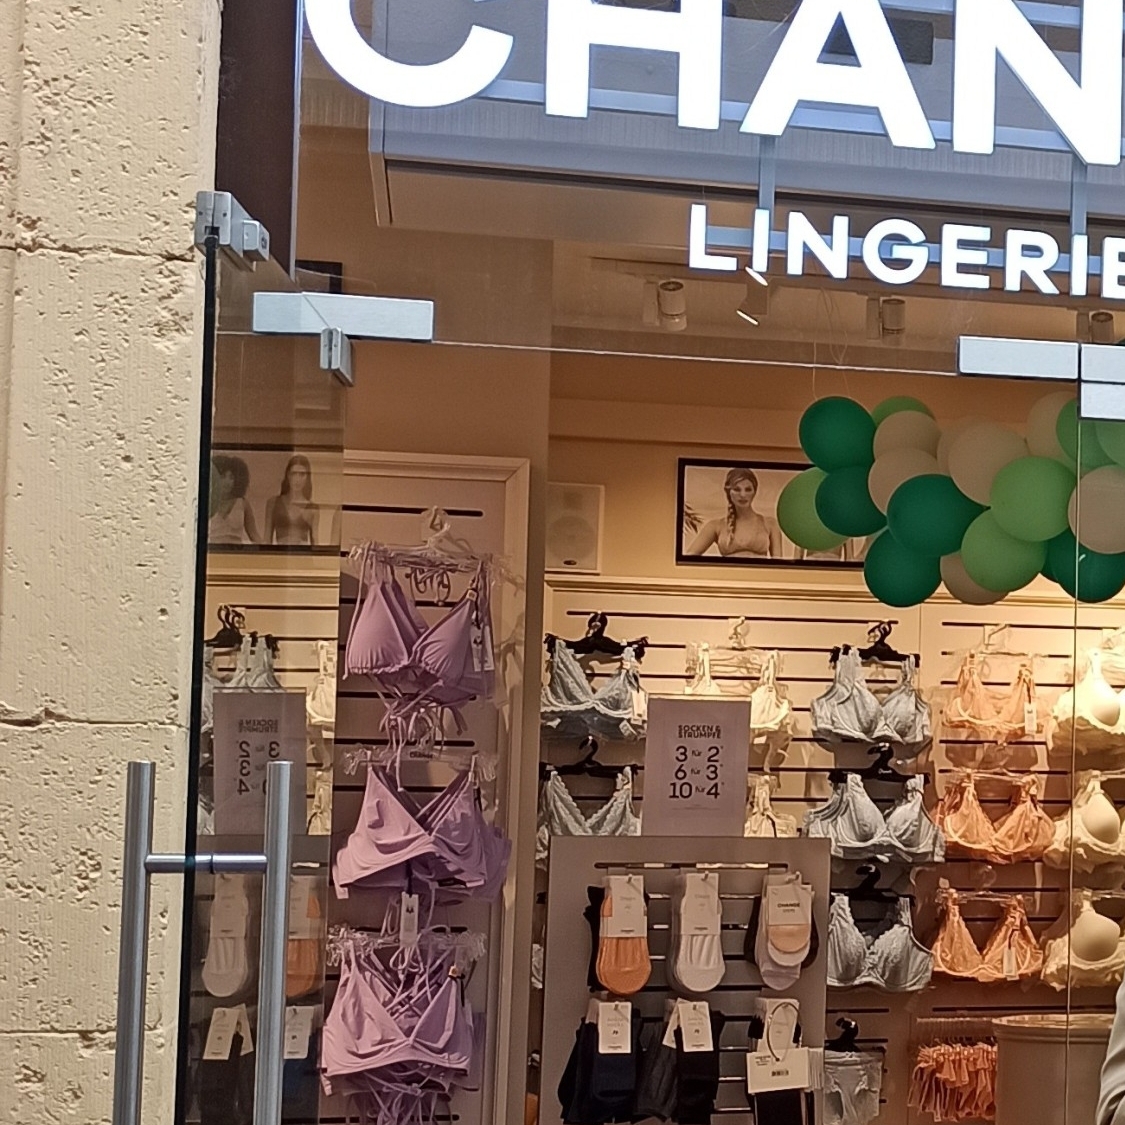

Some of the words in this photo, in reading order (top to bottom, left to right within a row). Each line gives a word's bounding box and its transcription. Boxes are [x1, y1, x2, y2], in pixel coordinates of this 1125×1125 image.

[675, 745, 688, 762] 3
[674, 763, 687, 780] 6
[668, 782, 692, 799] 10
